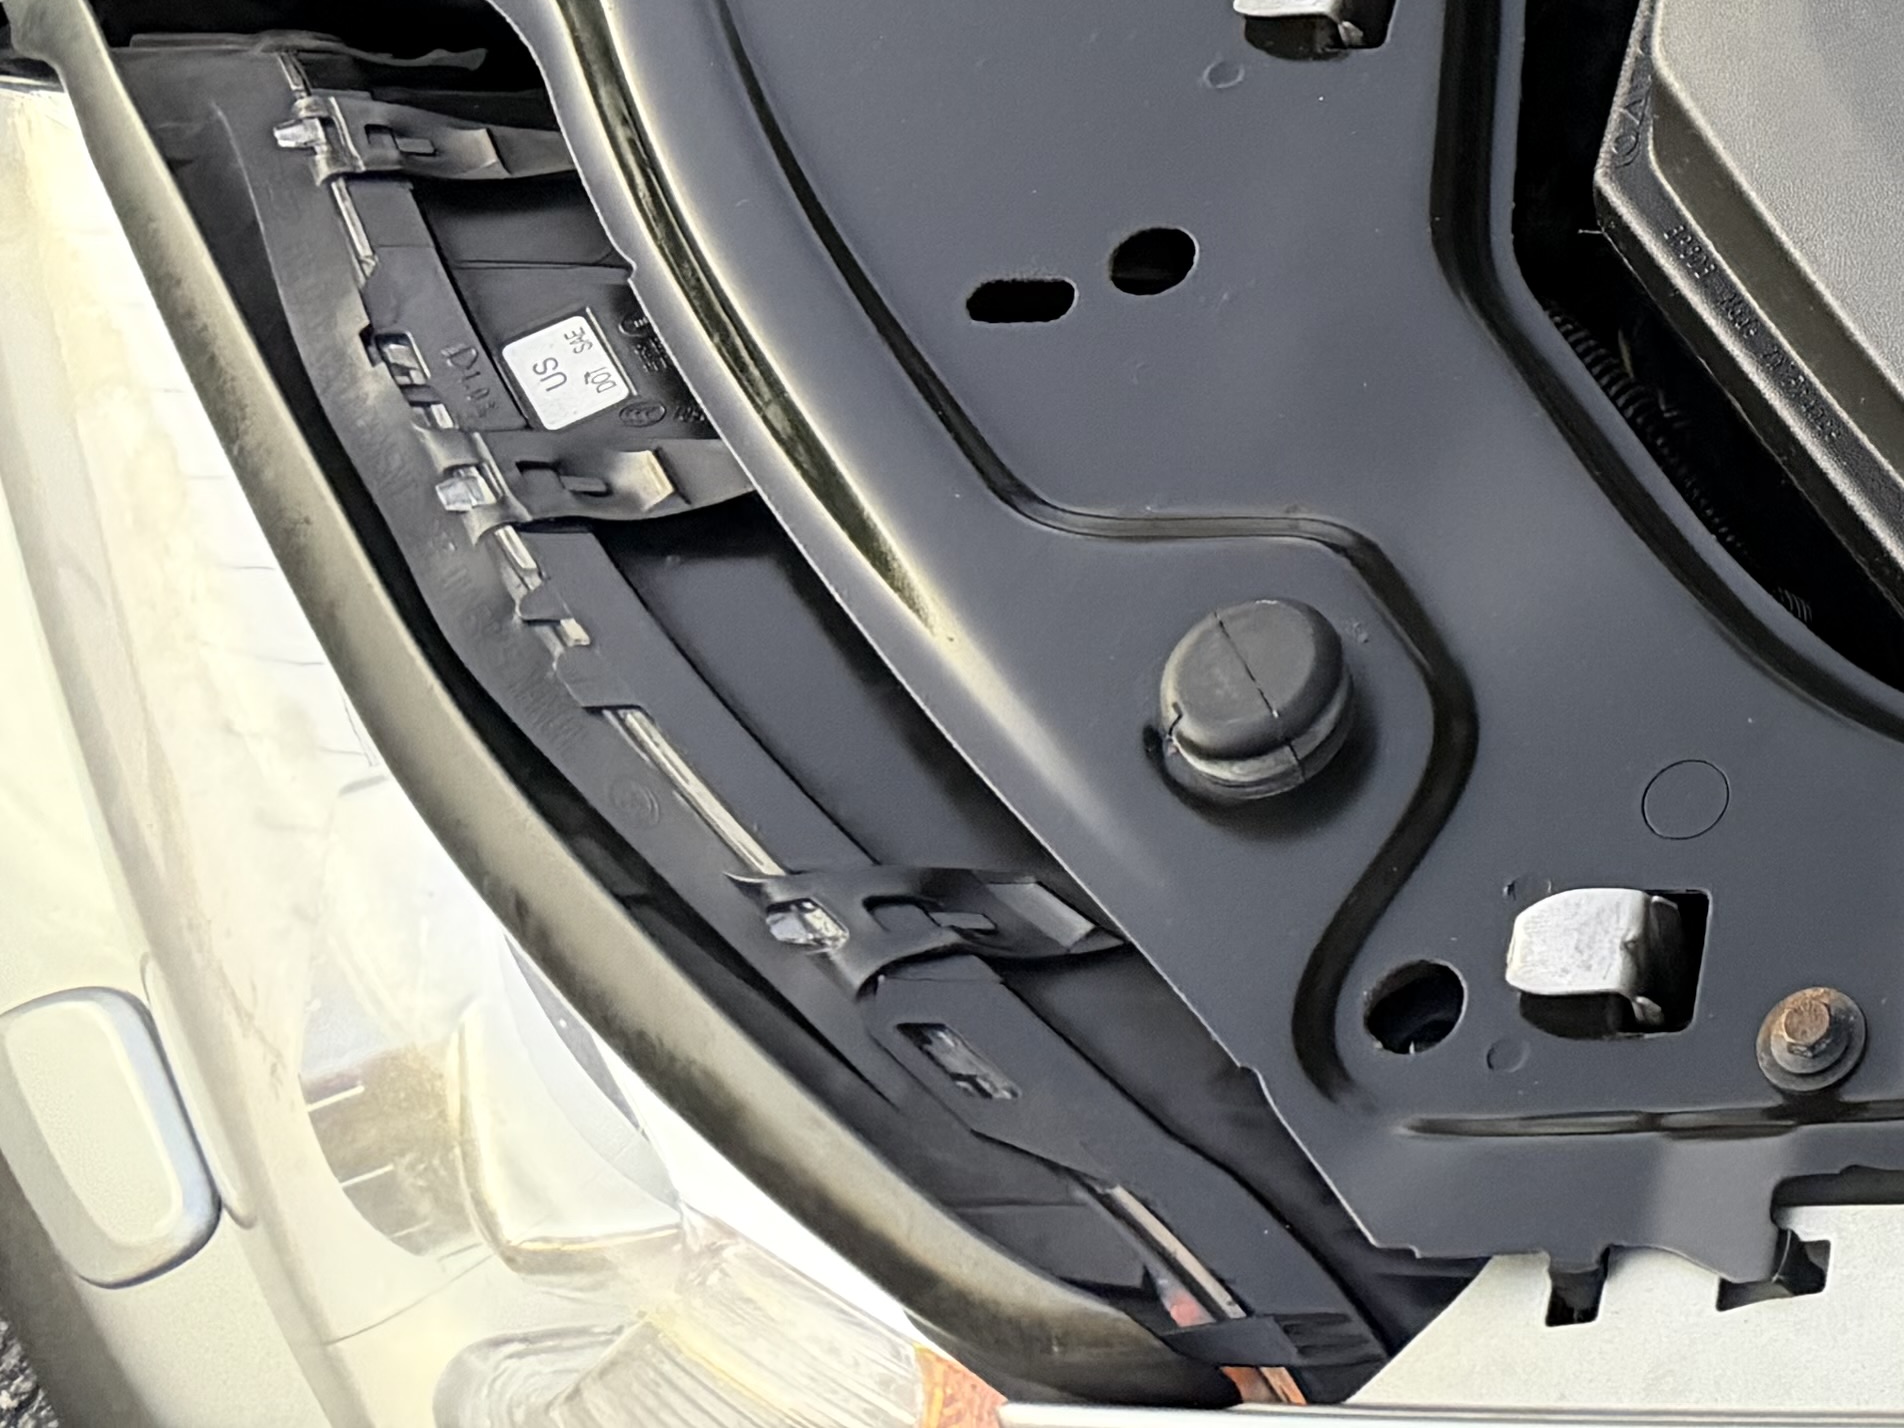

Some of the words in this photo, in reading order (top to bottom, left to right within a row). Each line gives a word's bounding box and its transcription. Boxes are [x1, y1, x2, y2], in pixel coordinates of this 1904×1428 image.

[563, 326, 594, 355] SAE
[532, 356, 568, 392] US
[583, 366, 618, 394] DOT
